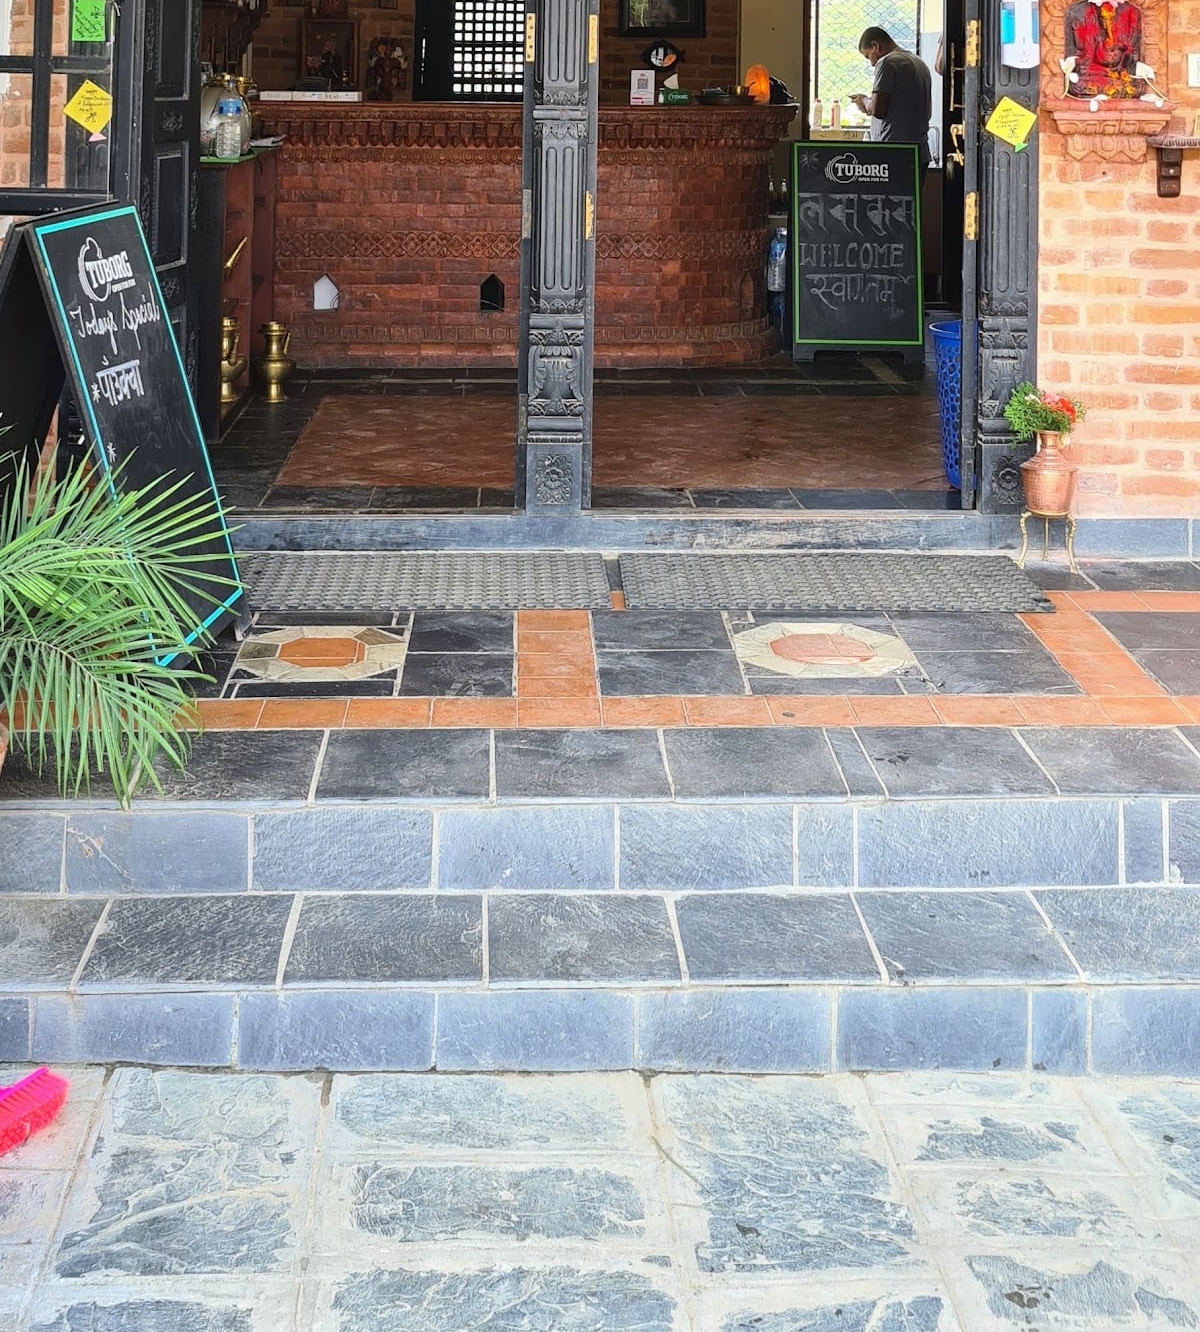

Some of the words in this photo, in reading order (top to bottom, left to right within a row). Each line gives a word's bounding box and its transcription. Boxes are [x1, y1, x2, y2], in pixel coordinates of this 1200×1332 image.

[835, 163, 889, 177] TUBORG
[800, 242, 904, 269] WELCOME
[85, 250, 133, 289] TUBORG
